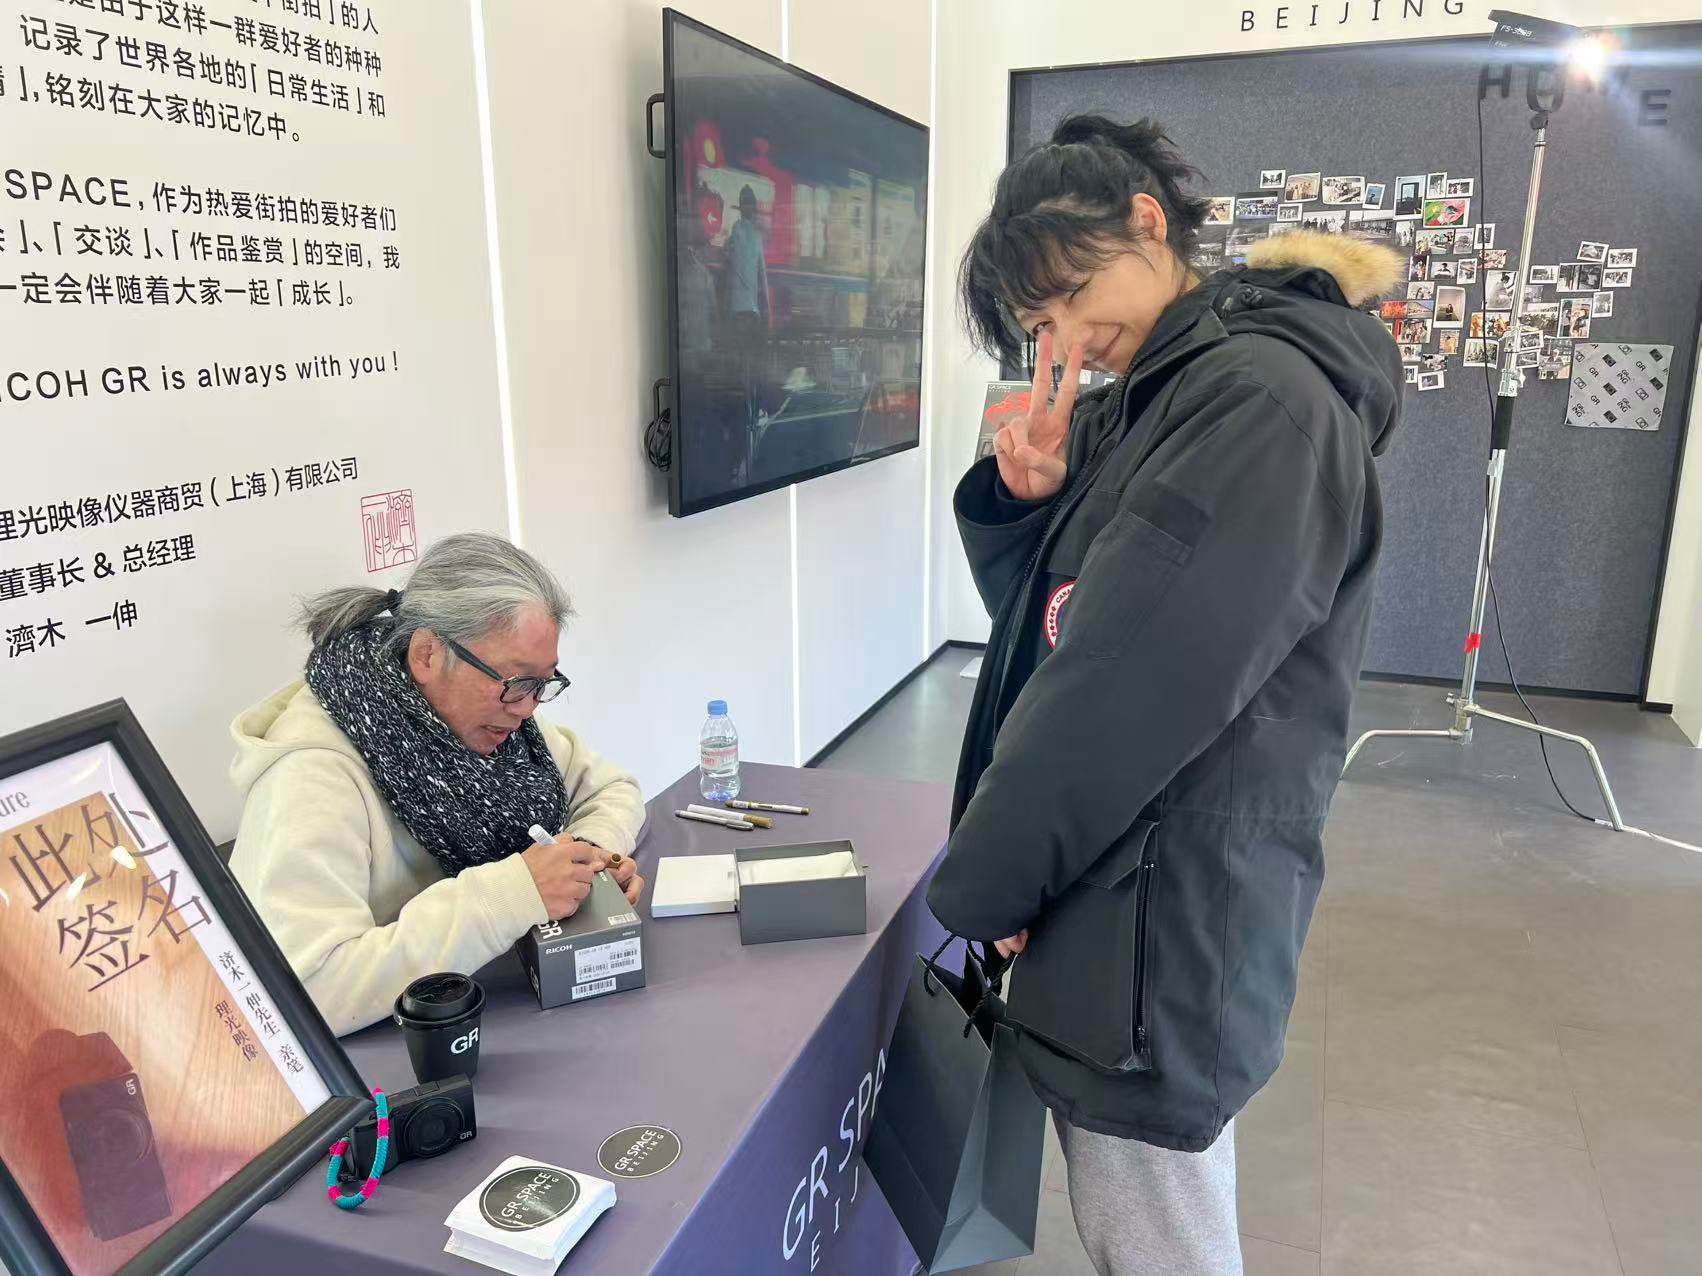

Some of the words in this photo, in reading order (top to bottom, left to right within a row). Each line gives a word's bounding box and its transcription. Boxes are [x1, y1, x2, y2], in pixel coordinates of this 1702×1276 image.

[1240, 0, 1464, 32] BEIJING
[0, 369, 88, 402] COH
[101, 366, 151, 395] GR
[161, 365, 186, 391] is
[198, 362, 288, 387] always
[296, 356, 342, 379] with
[1589, 367, 1600, 378] GR
[94, 552, 116, 579] &
[123, 534, 196, 573] 总经理
[1055, 589, 1071, 604] CANA
[545, 944, 573, 955] RICOH
[450, 1027, 479, 1055] GR
[460, 1130, 473, 1141] GR
[614, 1156, 633, 1172] GR
[626, 1129, 657, 1157] SPACE
[627, 1134, 665, 1172] BEIJING
[782, 1145, 829, 1261] GR
[838, 1048, 886, 1173] SPA
[501, 1199, 523, 1218] GR
[516, 1172, 552, 1202] SPACE
